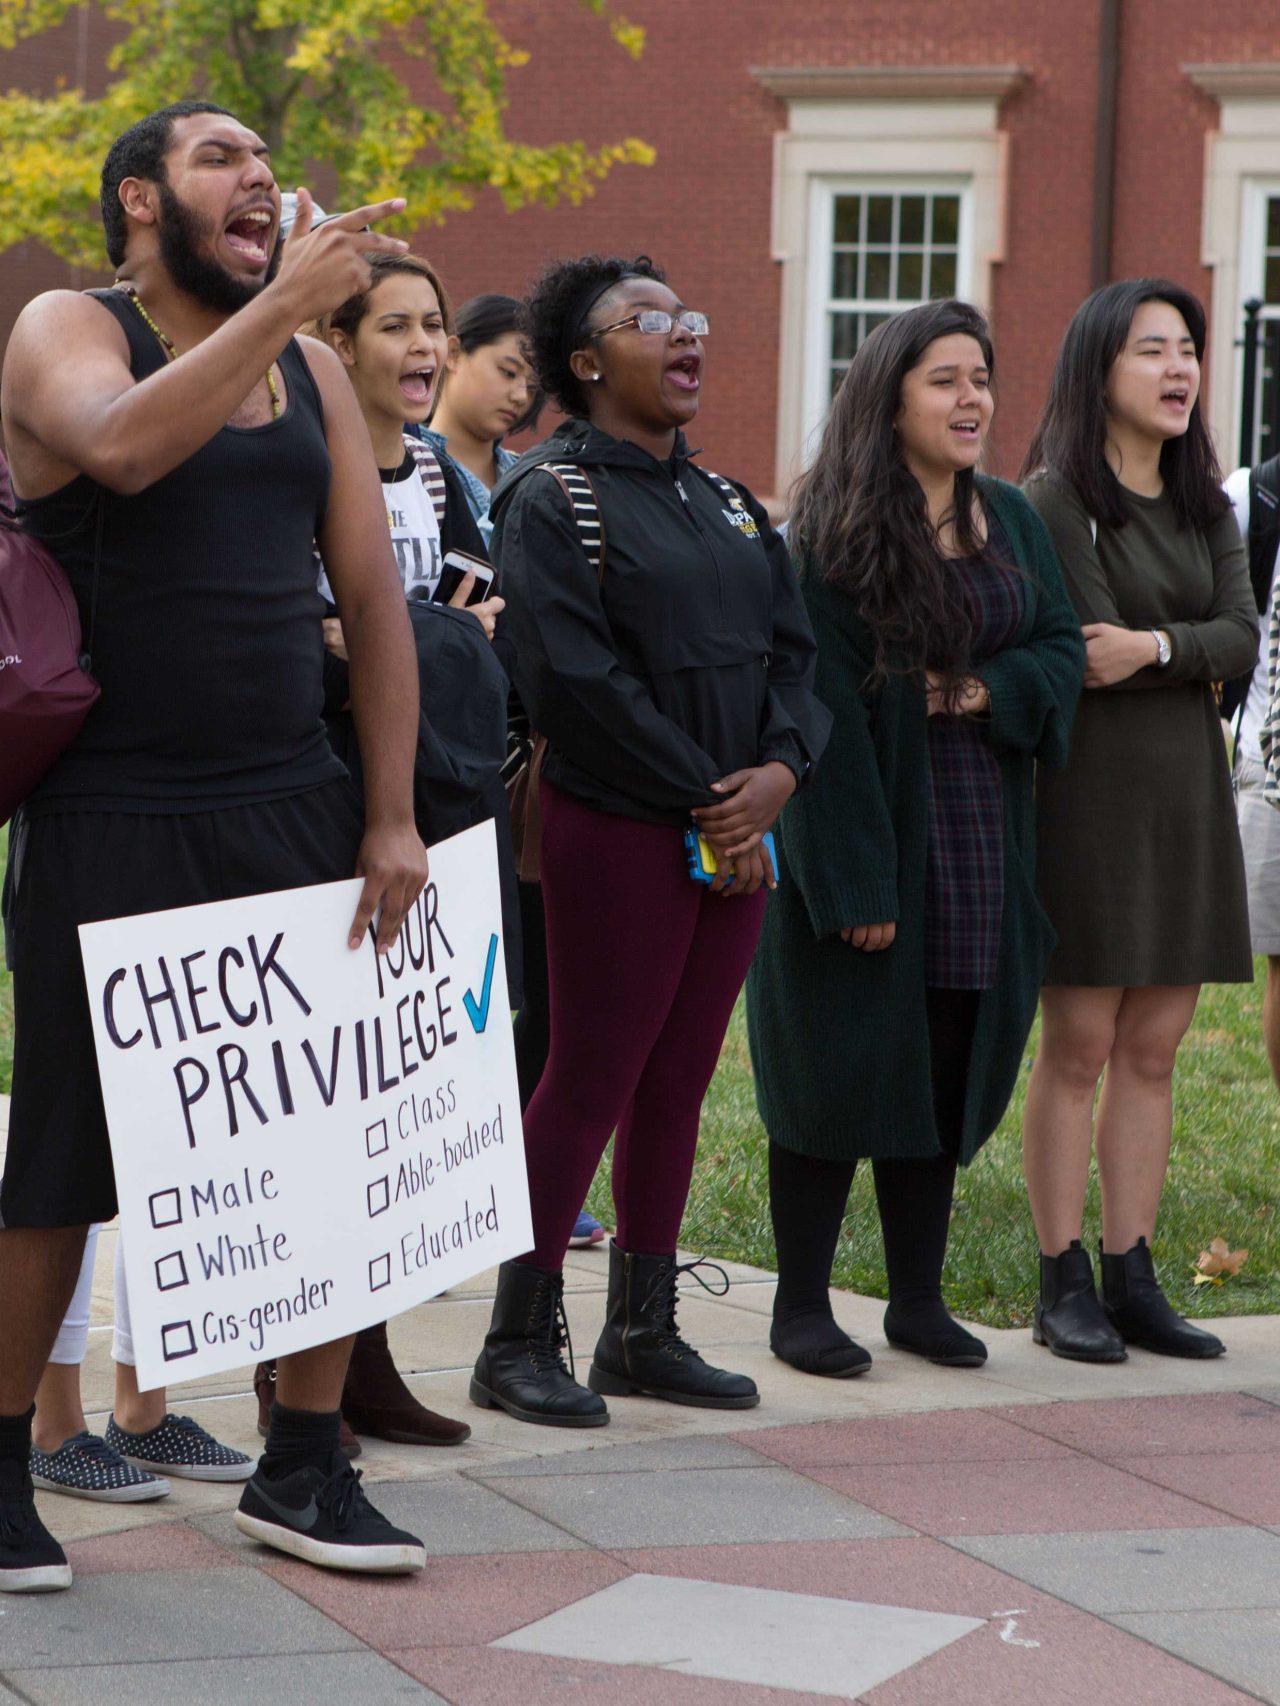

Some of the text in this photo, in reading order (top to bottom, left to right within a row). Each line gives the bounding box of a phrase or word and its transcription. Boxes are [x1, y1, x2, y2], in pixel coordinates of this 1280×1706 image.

[103, 932, 312, 1050] CHECK
[173, 976, 458, 1149] PRIVILEGE
[397, 1079, 457, 1141] Class
[190, 1167, 280, 1220] Male
[394, 1104, 504, 1202] Able-bodied
[196, 1224, 293, 1281] White
[400, 1185, 500, 1278] Educated
[203, 1277, 335, 1352] Cis-gender
